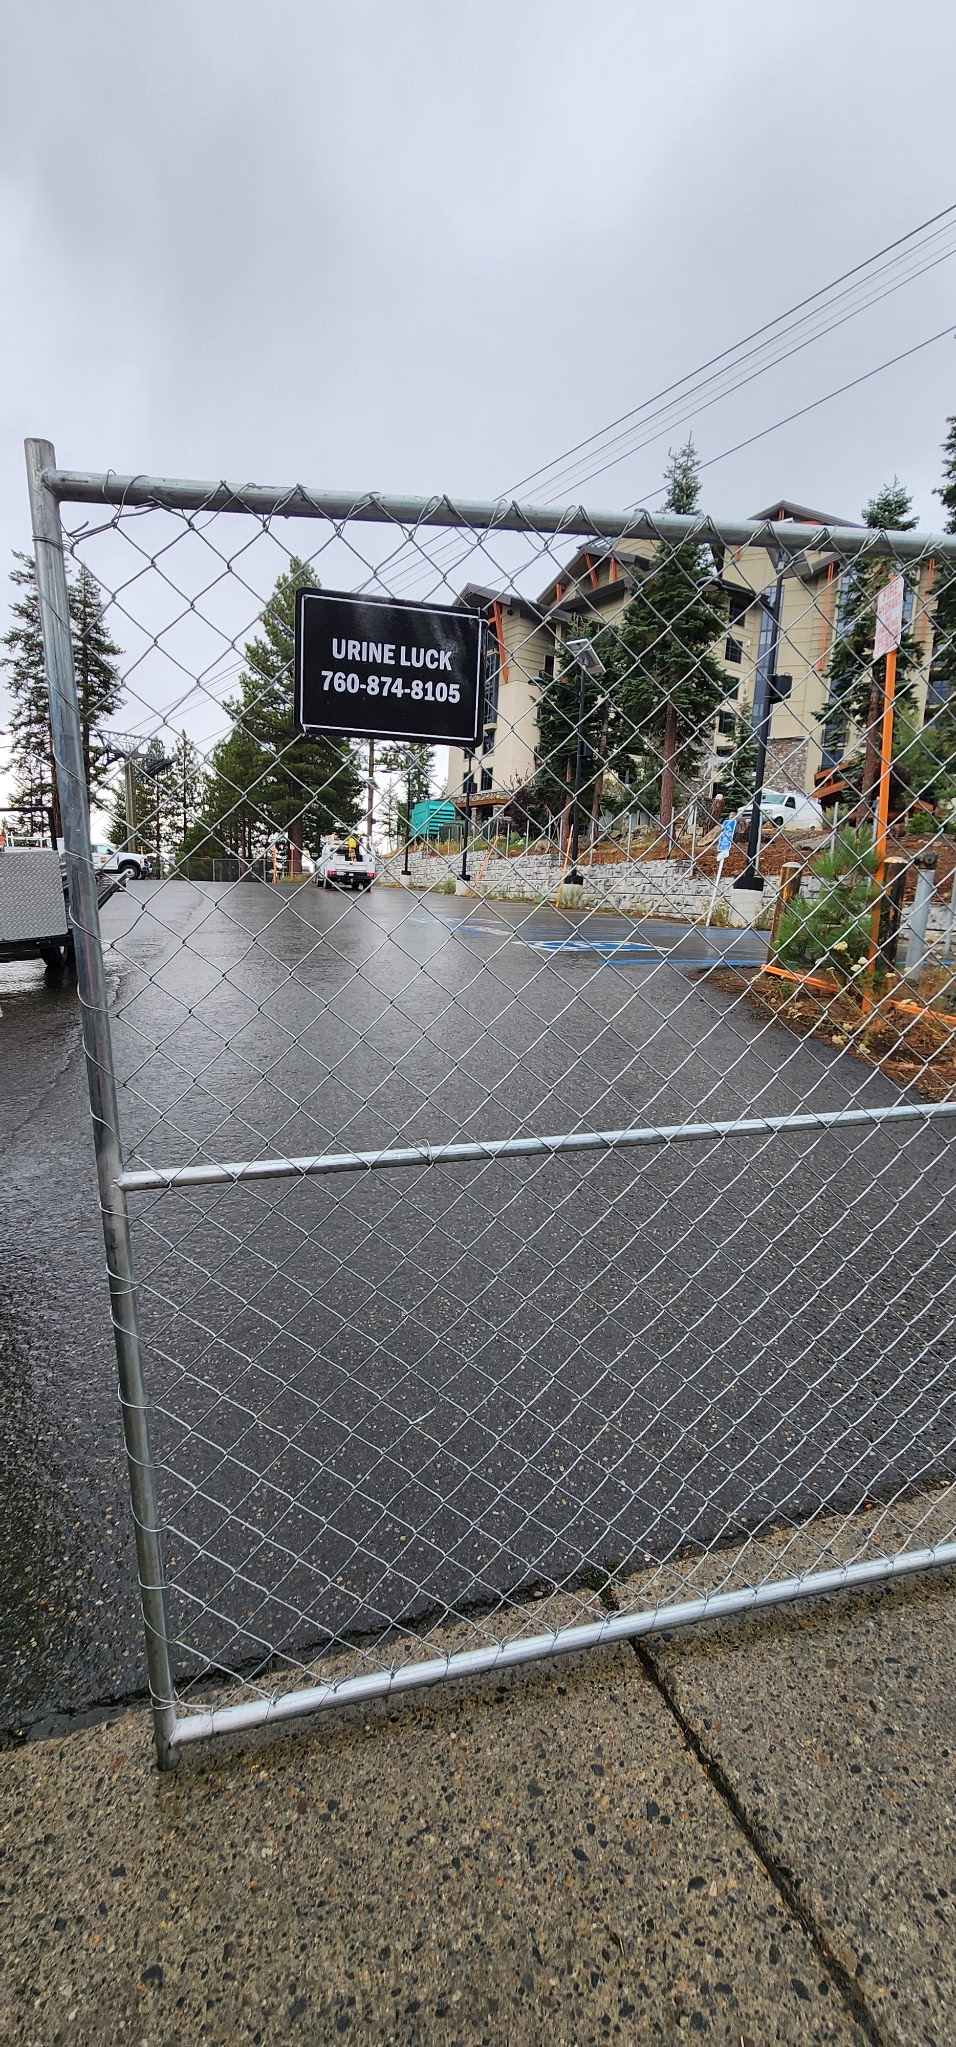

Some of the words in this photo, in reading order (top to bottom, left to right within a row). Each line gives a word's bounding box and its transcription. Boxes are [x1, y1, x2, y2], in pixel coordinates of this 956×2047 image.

[332, 637, 396, 665] URINE
[400, 646, 453, 671] LUCK
[321, 670, 461, 704] 760-874-8105
